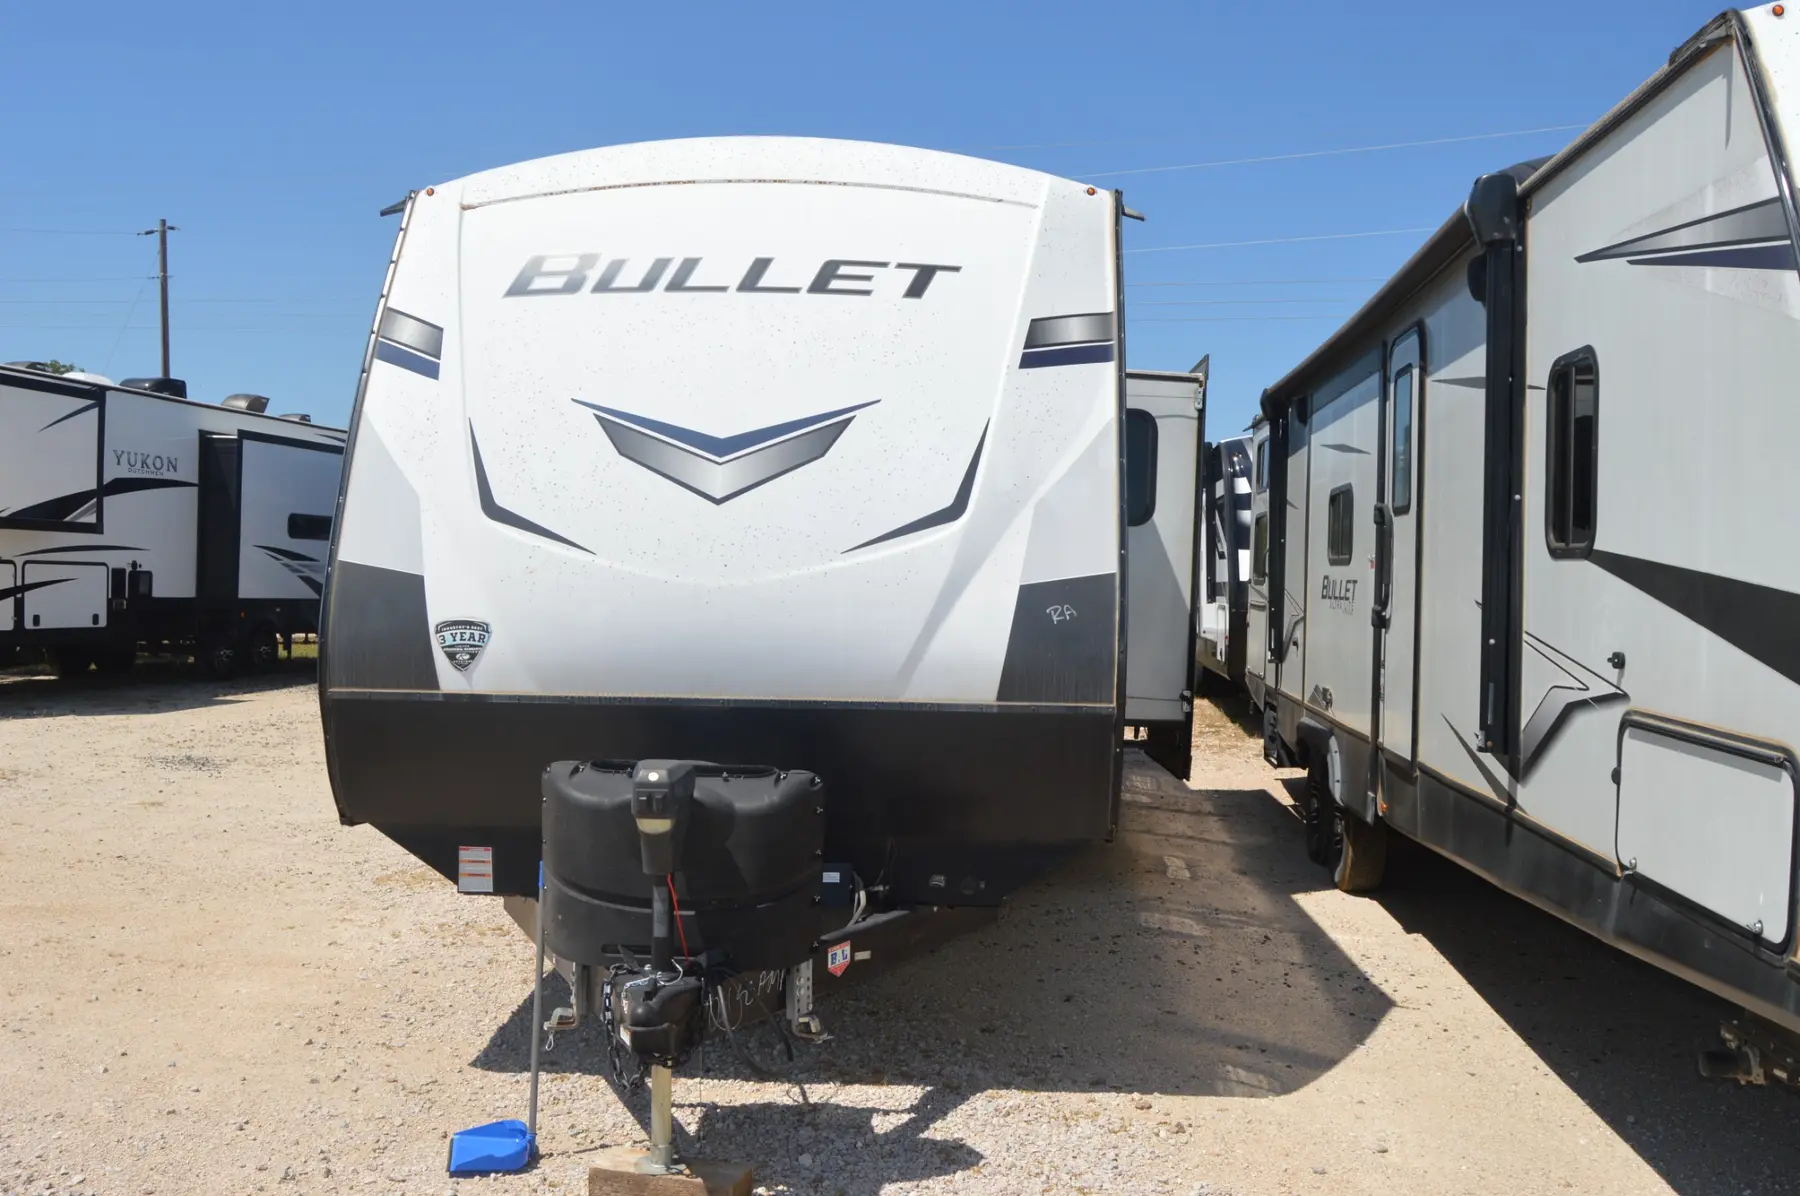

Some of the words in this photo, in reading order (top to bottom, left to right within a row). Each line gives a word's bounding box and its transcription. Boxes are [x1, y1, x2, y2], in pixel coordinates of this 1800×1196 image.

[502, 252, 962, 299] BULLET
[112, 449, 178, 473] YUKON
[1321, 574, 1358, 602] BULLET
[438, 634, 446, 645] 3
[450, 631, 486, 643] YEAR
